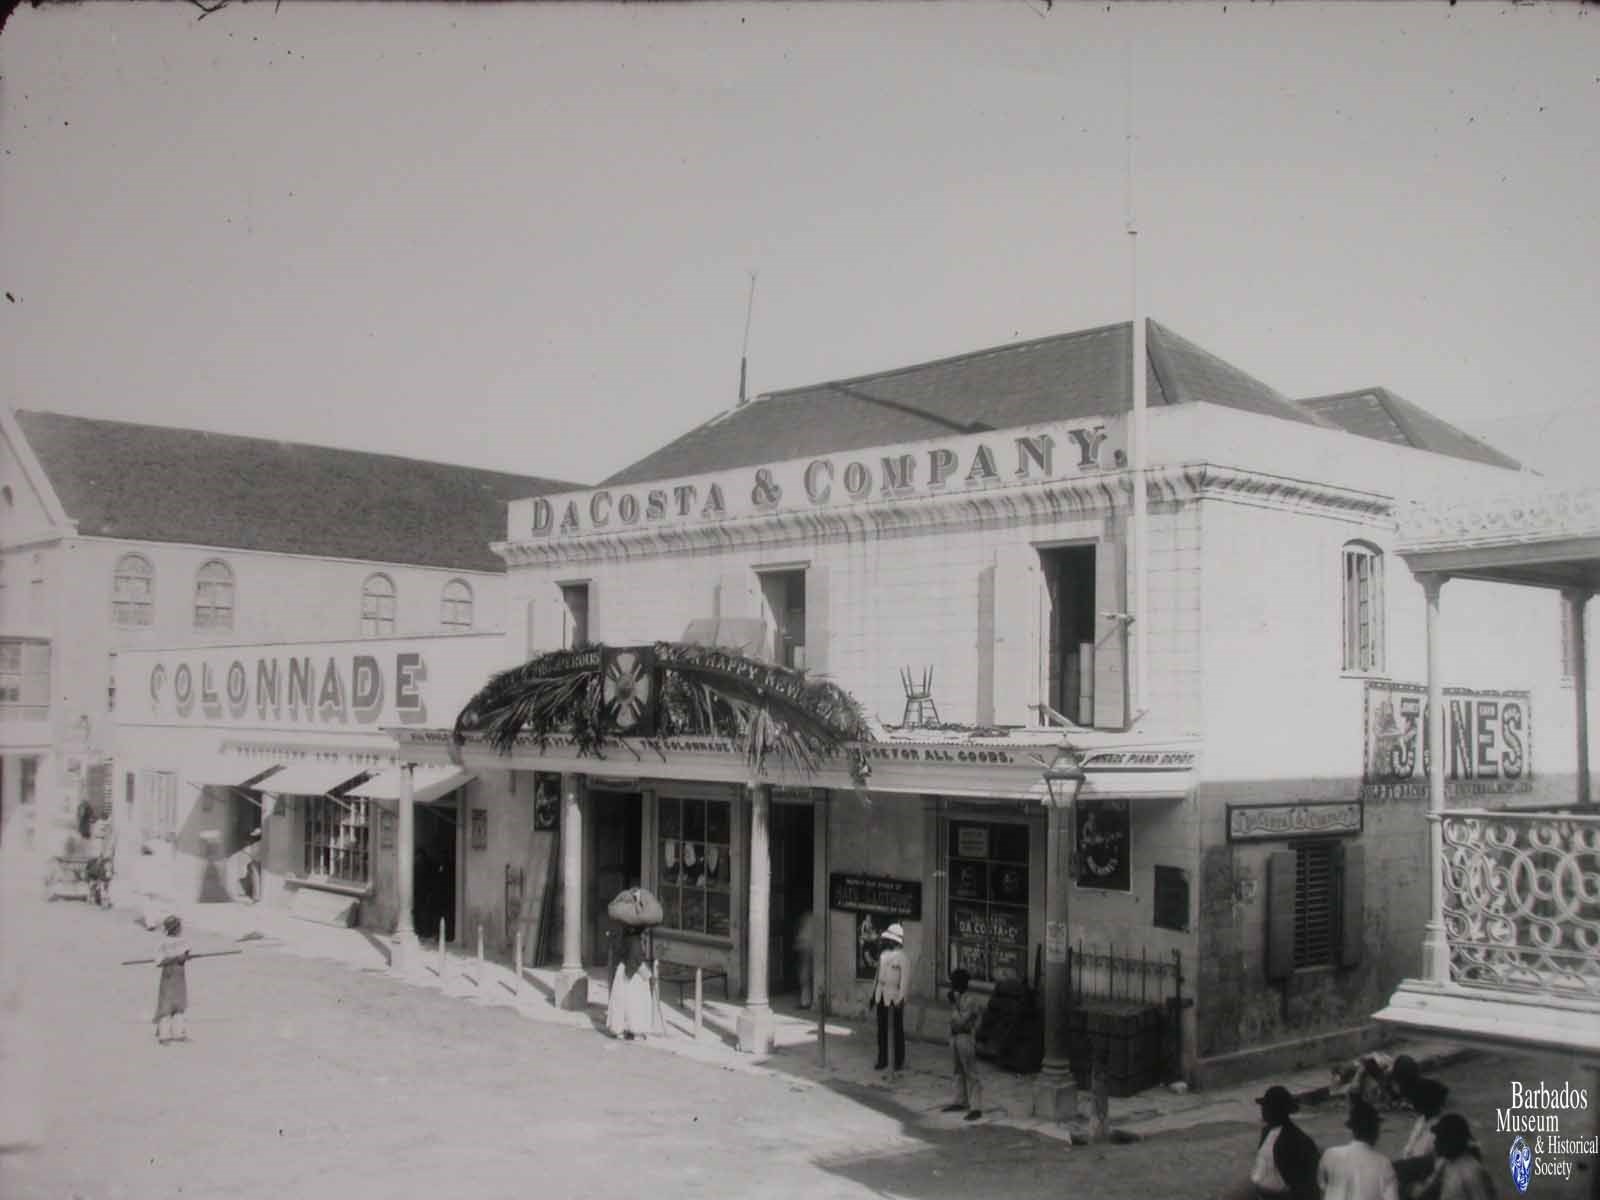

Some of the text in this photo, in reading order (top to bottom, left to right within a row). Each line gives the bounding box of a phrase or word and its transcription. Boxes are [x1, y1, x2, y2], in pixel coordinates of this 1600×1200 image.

[752, 467, 784, 506] &
[150, 652, 428, 724] COLONNADE
[924, 749, 953, 762] ALL
